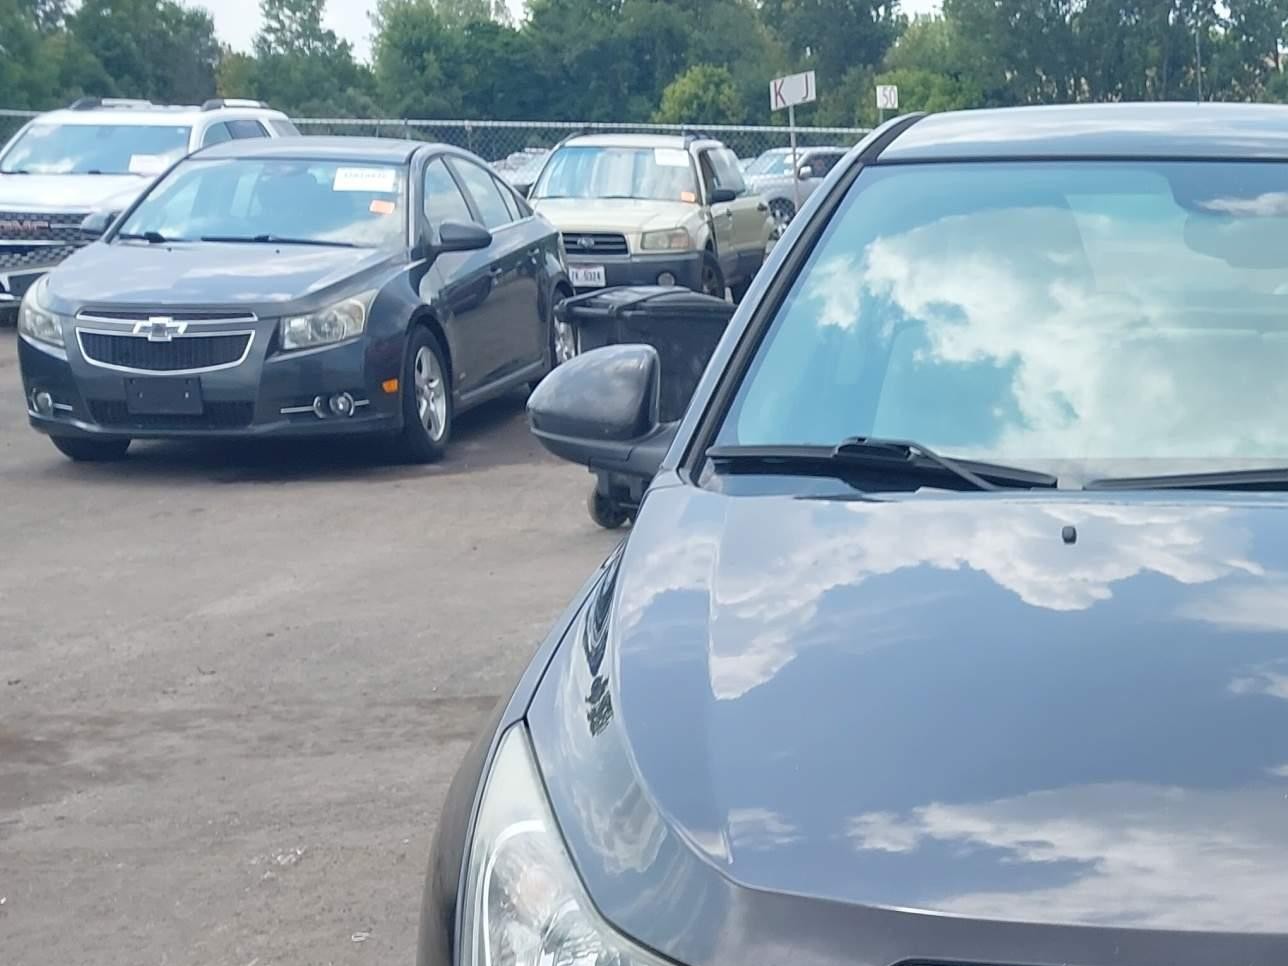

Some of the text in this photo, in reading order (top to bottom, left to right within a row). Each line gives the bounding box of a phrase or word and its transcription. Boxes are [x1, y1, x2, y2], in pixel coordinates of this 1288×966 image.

[774, 73, 809, 107] K J
[881, 87, 897, 107] 50
